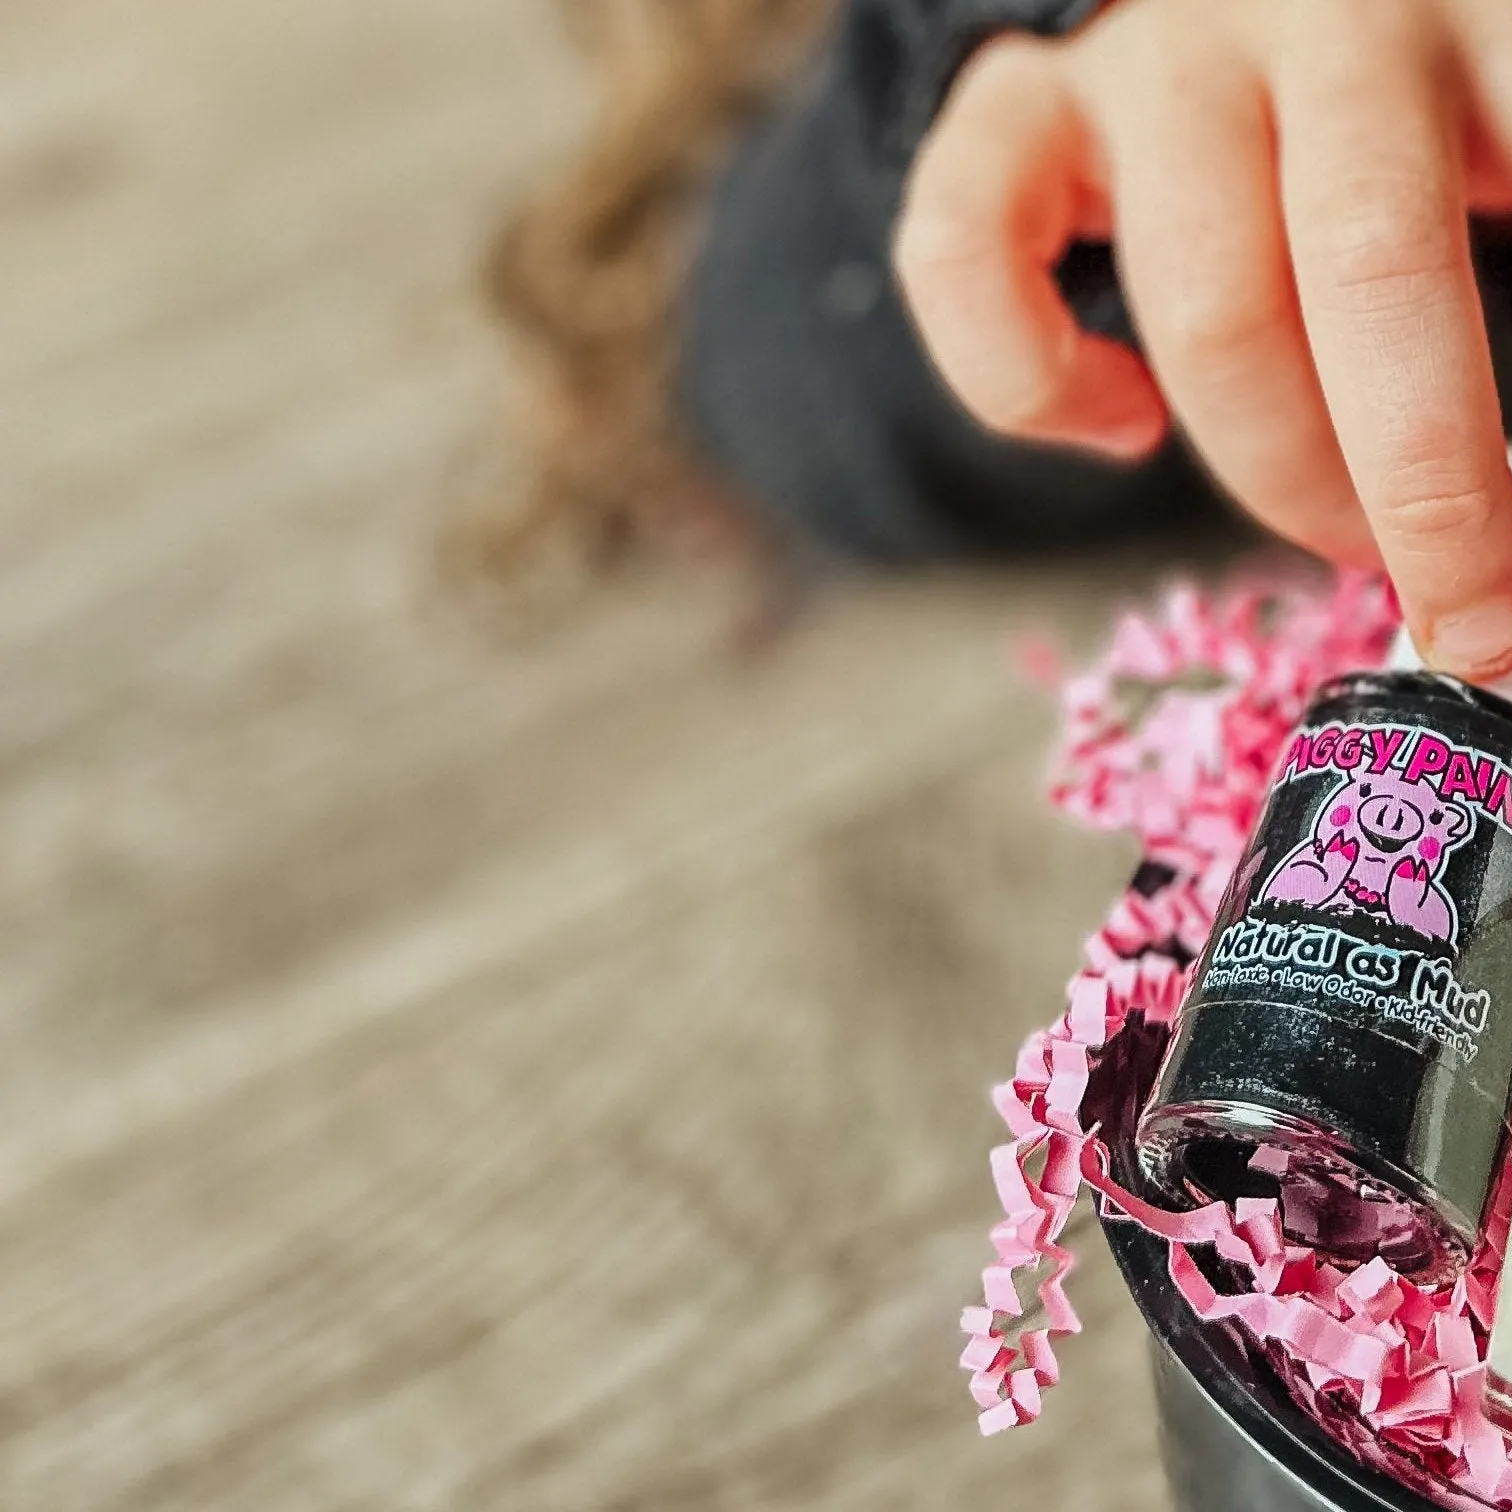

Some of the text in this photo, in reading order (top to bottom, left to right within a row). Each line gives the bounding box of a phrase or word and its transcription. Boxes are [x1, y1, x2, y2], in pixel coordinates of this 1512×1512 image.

[1275, 727, 1404, 785] PIGGY
[1214, 920, 1339, 968] Natural
[1347, 947, 1401, 986] as
[1282, 966, 1323, 992] Low
[1323, 975, 1377, 1008] Odor
